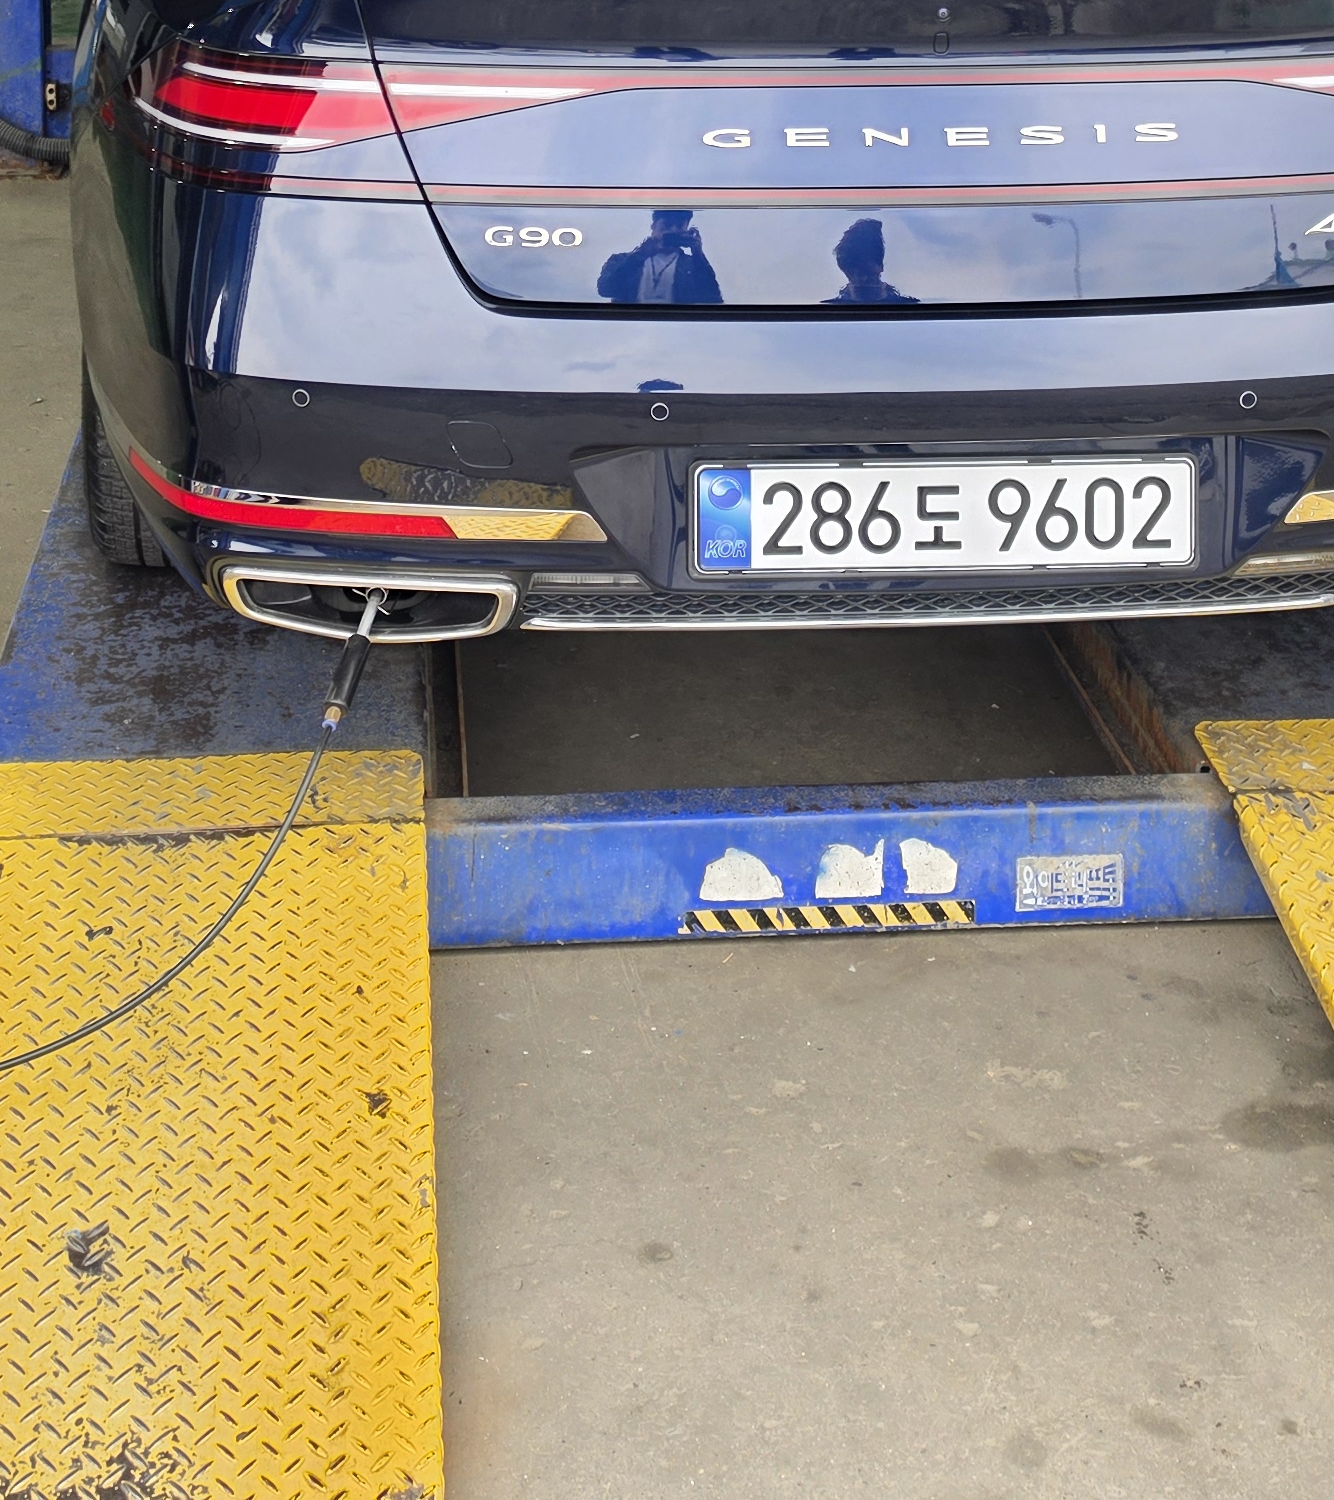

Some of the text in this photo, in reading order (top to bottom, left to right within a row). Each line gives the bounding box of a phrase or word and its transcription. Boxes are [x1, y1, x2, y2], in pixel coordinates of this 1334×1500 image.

[701, 122, 1179, 148] GENESIS
[484, 225, 583, 248] G90
[762, 476, 1172, 555] 286도 9602
[704, 539, 747, 559] KOR
